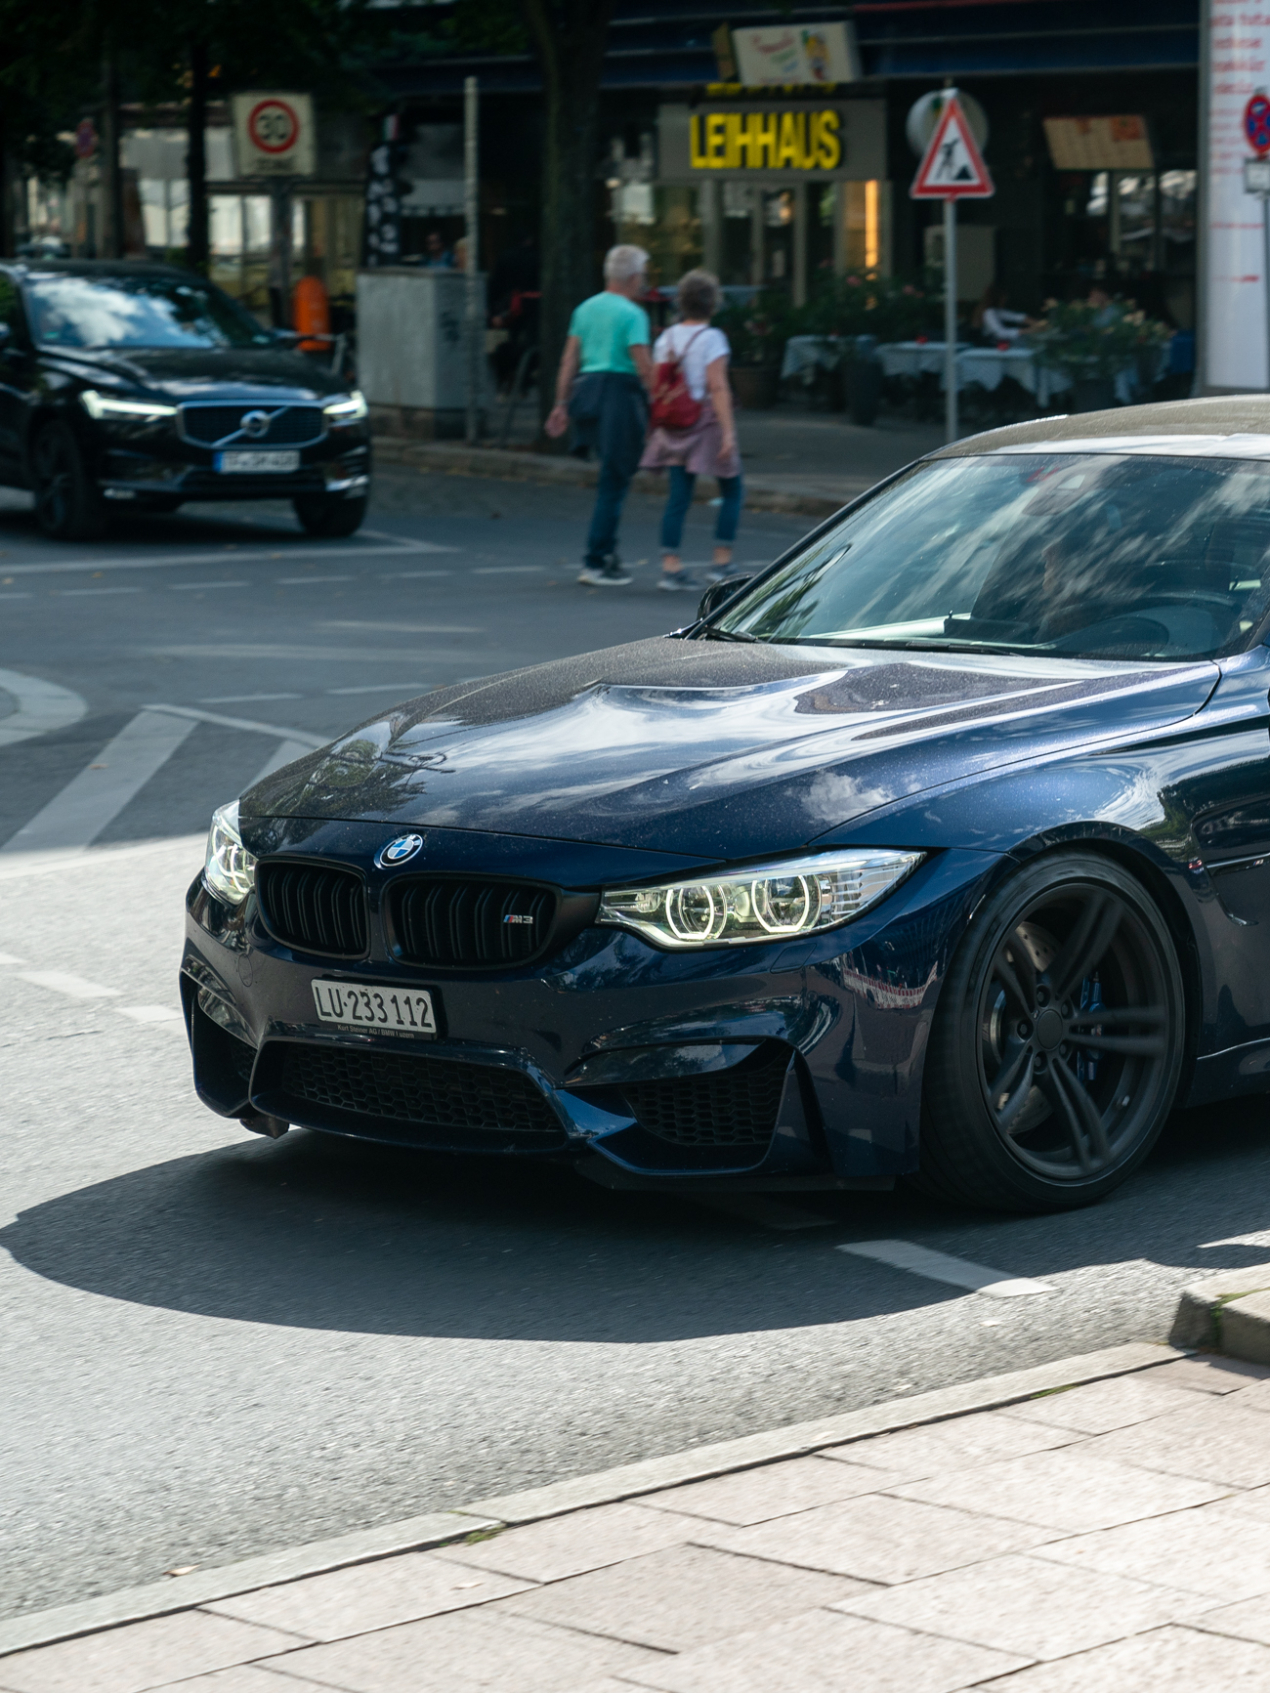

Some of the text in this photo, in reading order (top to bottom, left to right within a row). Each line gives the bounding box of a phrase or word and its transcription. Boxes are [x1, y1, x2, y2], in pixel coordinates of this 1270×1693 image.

[259, 113, 288, 141] 30
[690, 110, 841, 170] LEIHHAUS
[508, 914, 533, 924] M3
